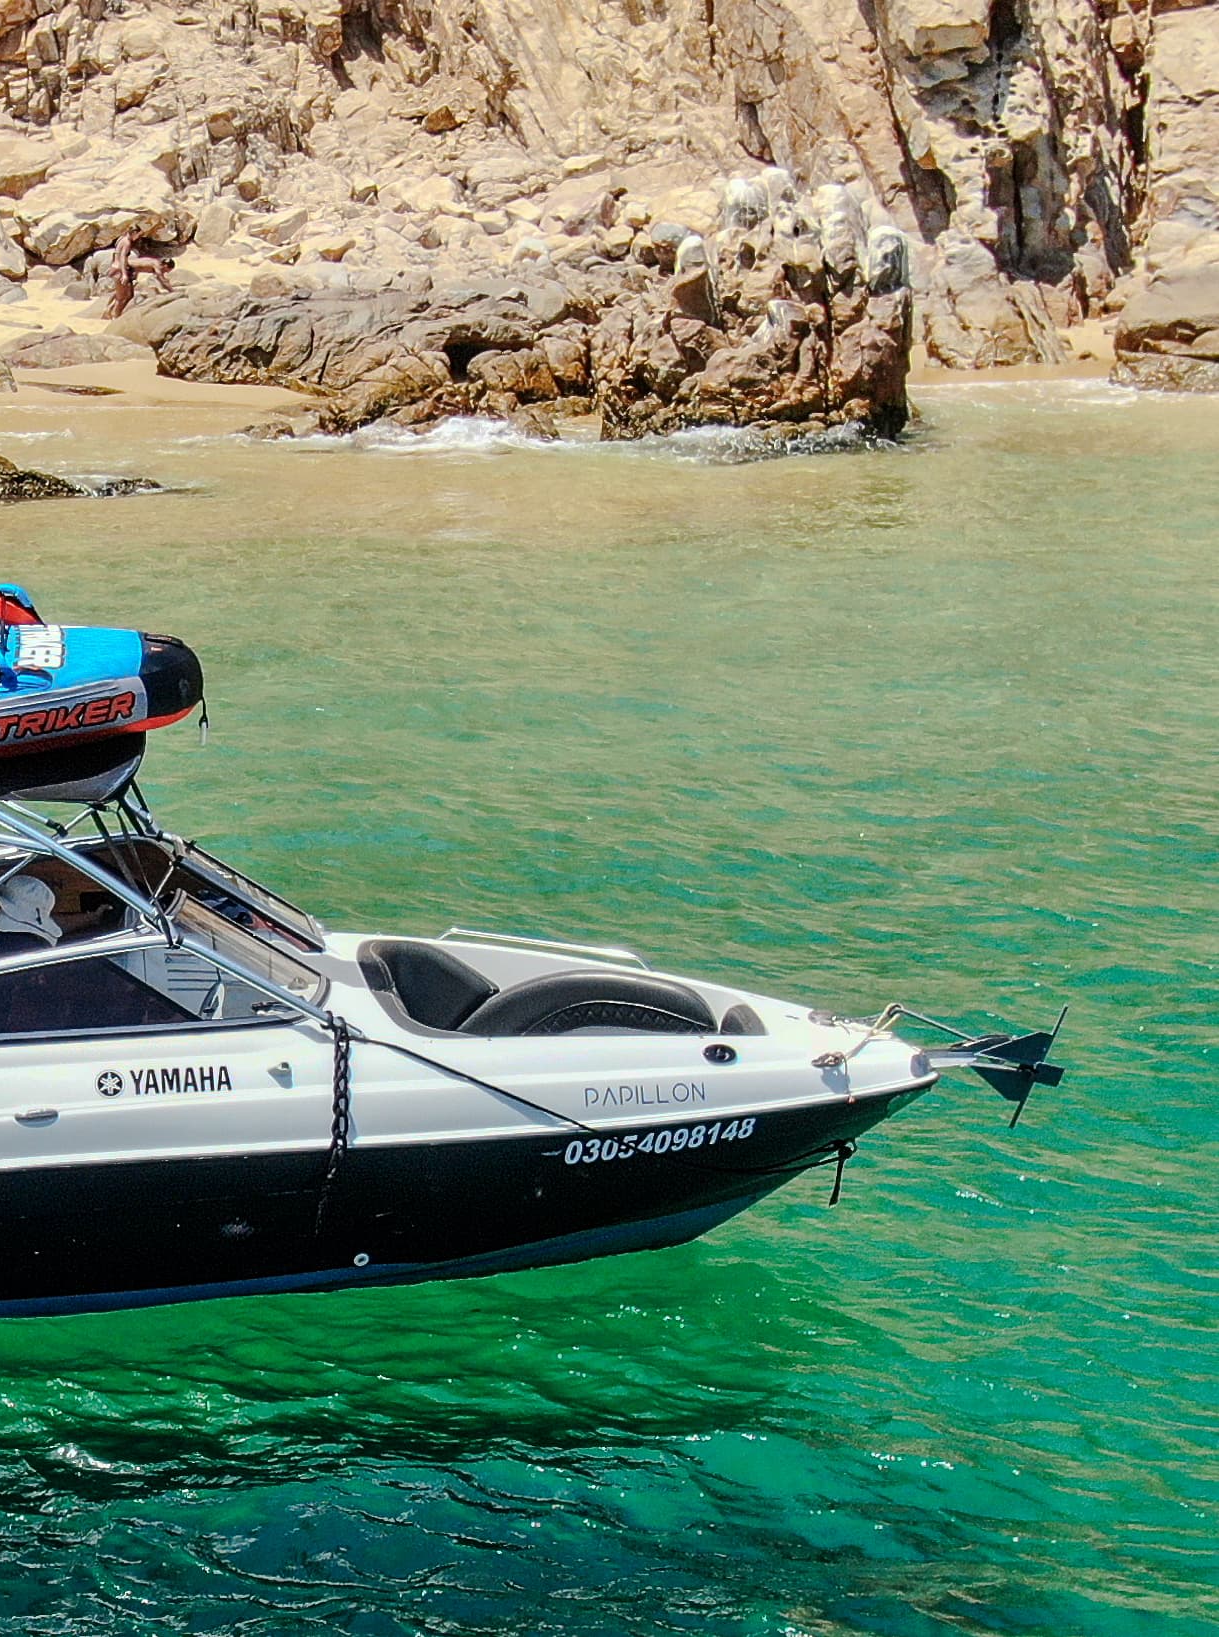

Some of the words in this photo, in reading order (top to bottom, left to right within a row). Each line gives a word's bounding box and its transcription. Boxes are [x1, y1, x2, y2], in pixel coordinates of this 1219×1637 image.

[130, 1066, 232, 1095] YAMAHA
[584, 1082, 705, 1108] PAPILLON
[564, 1117, 756, 1165] 03054098148
